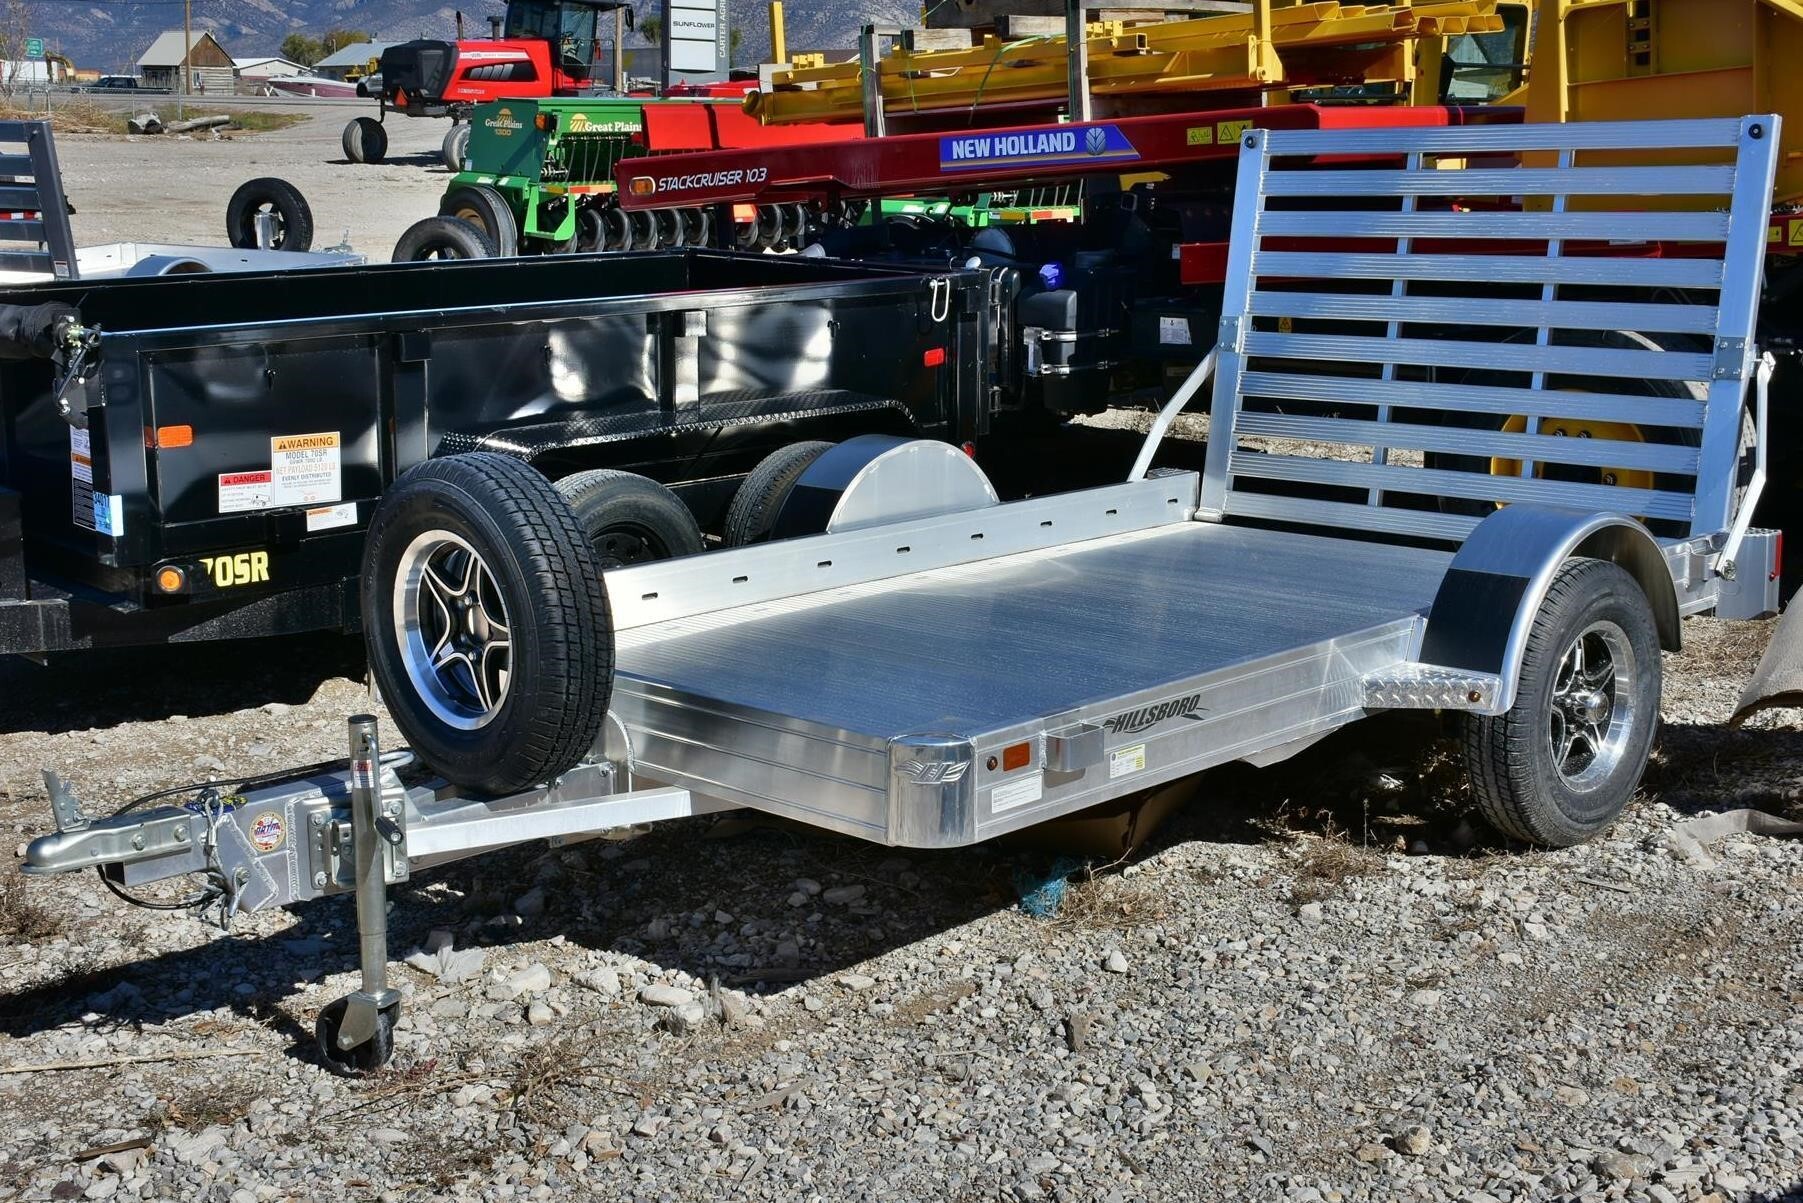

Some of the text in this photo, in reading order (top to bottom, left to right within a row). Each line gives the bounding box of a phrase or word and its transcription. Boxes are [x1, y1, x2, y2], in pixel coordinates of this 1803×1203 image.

[672, 21, 715, 29] SUNFLOWER
[484, 118, 523, 129] Great Plains
[584, 121, 612, 132] Great
[952, 132, 1076, 160] NEW HOLLAND
[658, 167, 768, 192] STACKCRUISER 103
[287, 436, 334, 450] WARNING
[285, 451, 309, 460] MODEL
[288, 464, 313, 474] PAYLOAD
[233, 474, 266, 483] DANGER
[301, 472, 332, 480] DISTRIBUTED
[1111, 694, 1201, 734] HILLSBORO
